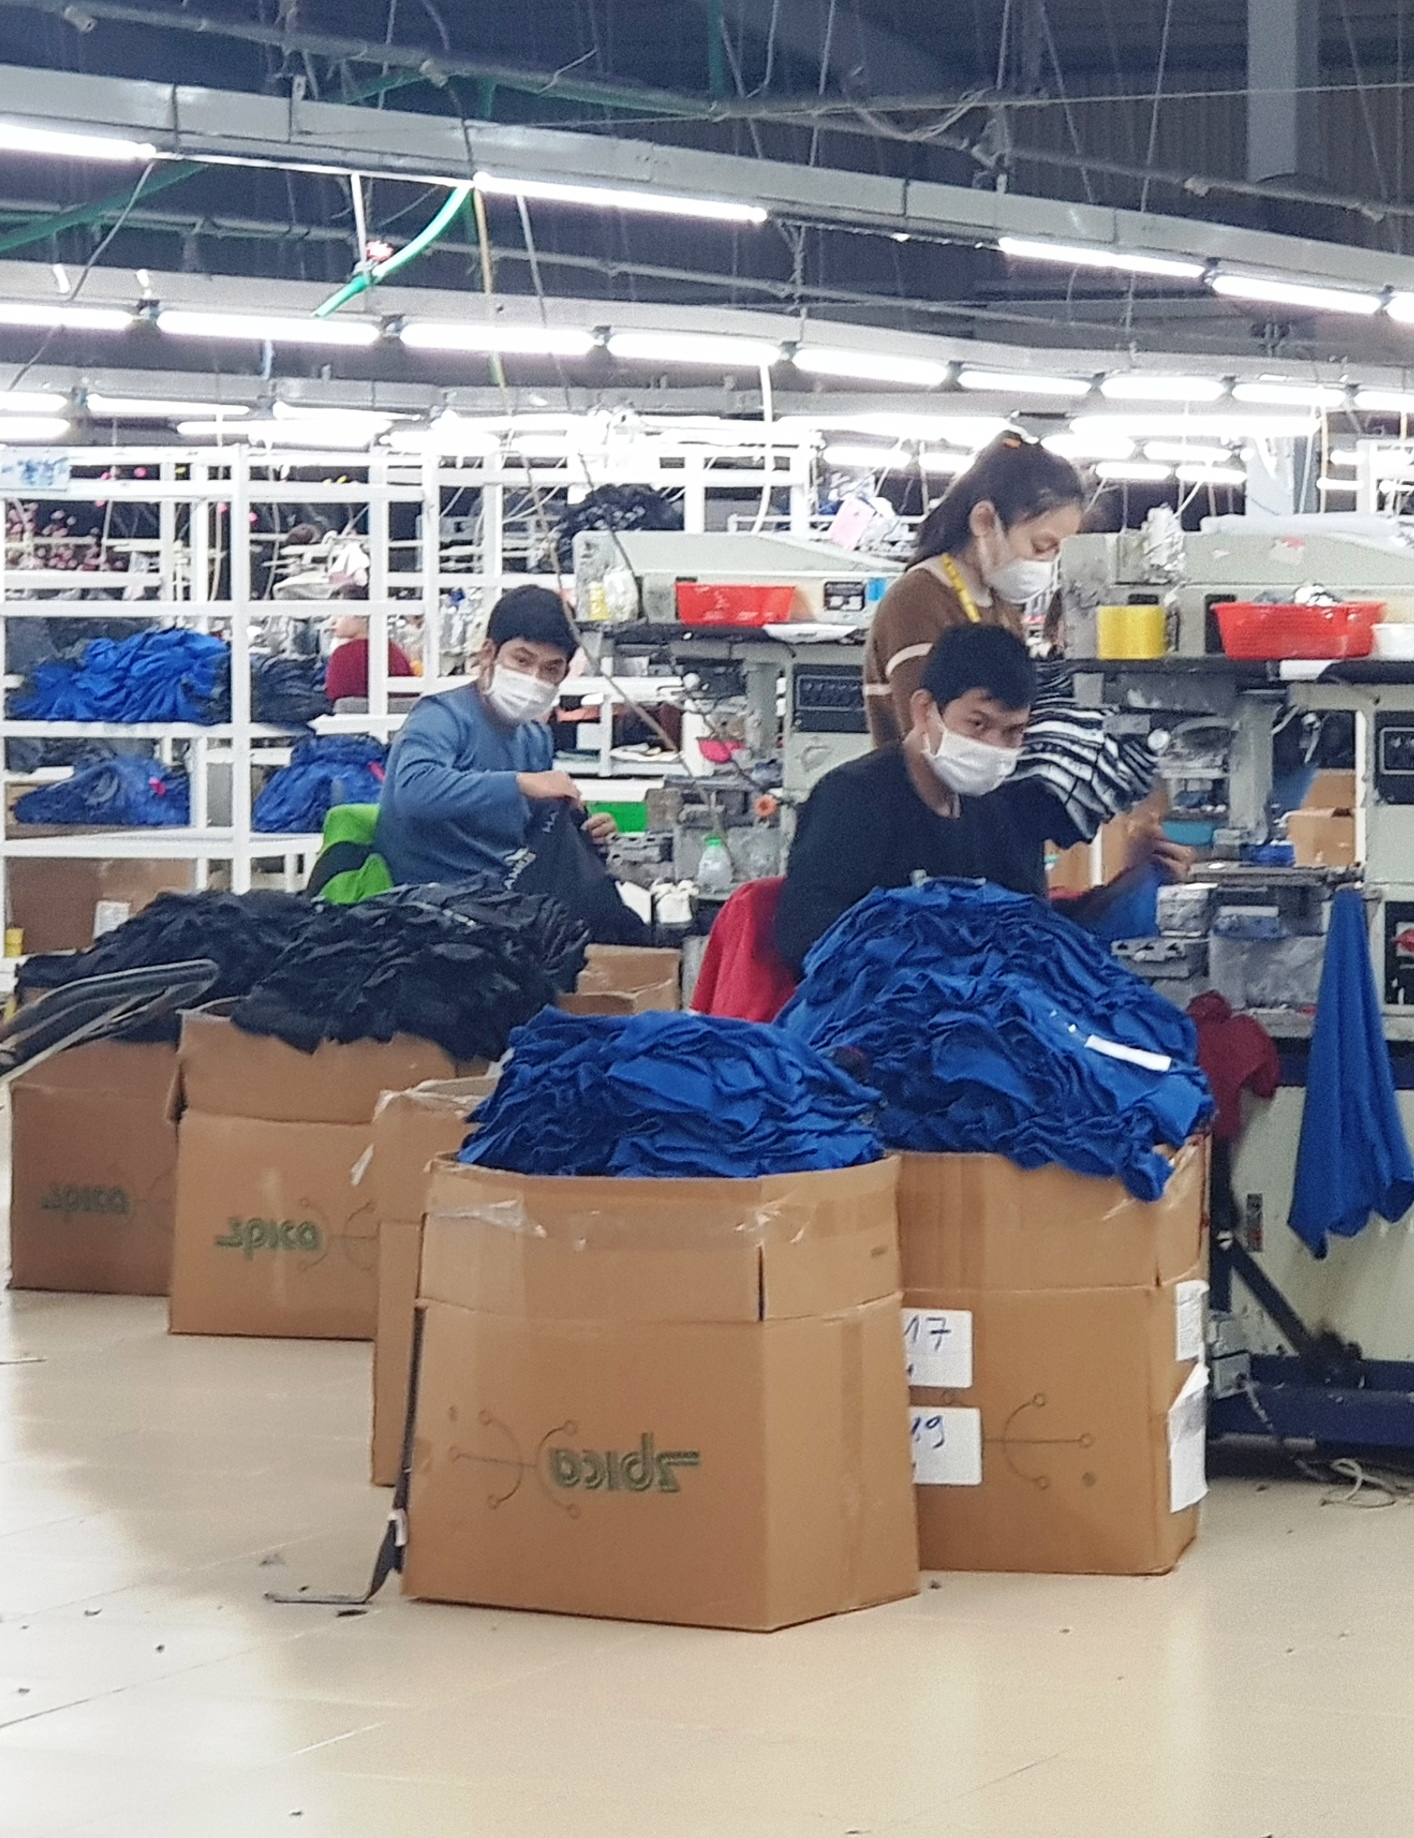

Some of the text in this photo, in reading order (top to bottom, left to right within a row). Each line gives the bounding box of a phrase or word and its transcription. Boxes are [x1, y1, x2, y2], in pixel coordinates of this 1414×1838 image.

[213, 1216, 321, 1260] spica
[904, 1315, 951, 1351] 17
[549, 1432, 699, 1492] spica
